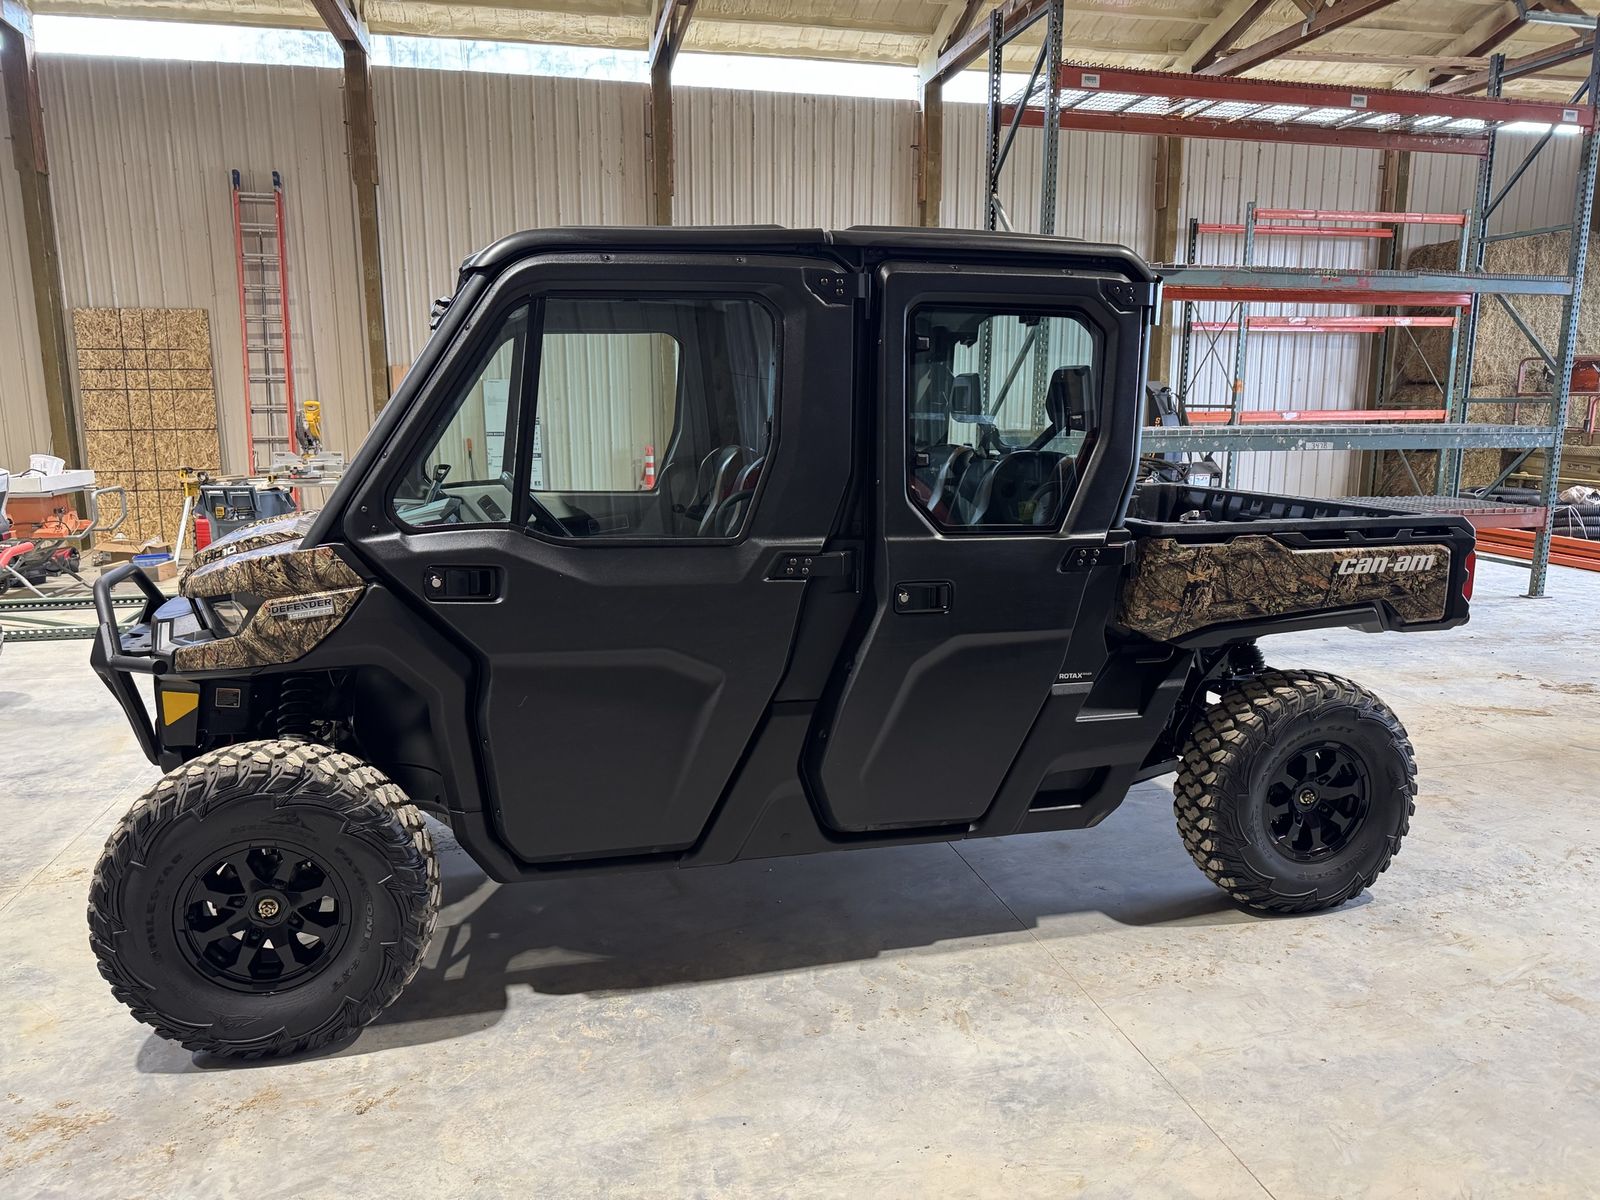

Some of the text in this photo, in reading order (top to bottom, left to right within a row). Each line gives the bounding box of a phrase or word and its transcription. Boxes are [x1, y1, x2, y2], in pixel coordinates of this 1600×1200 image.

[204, 545, 237, 562] HD10
[1338, 554, 1435, 575] can-am
[271, 598, 332, 614] DEFENDER
